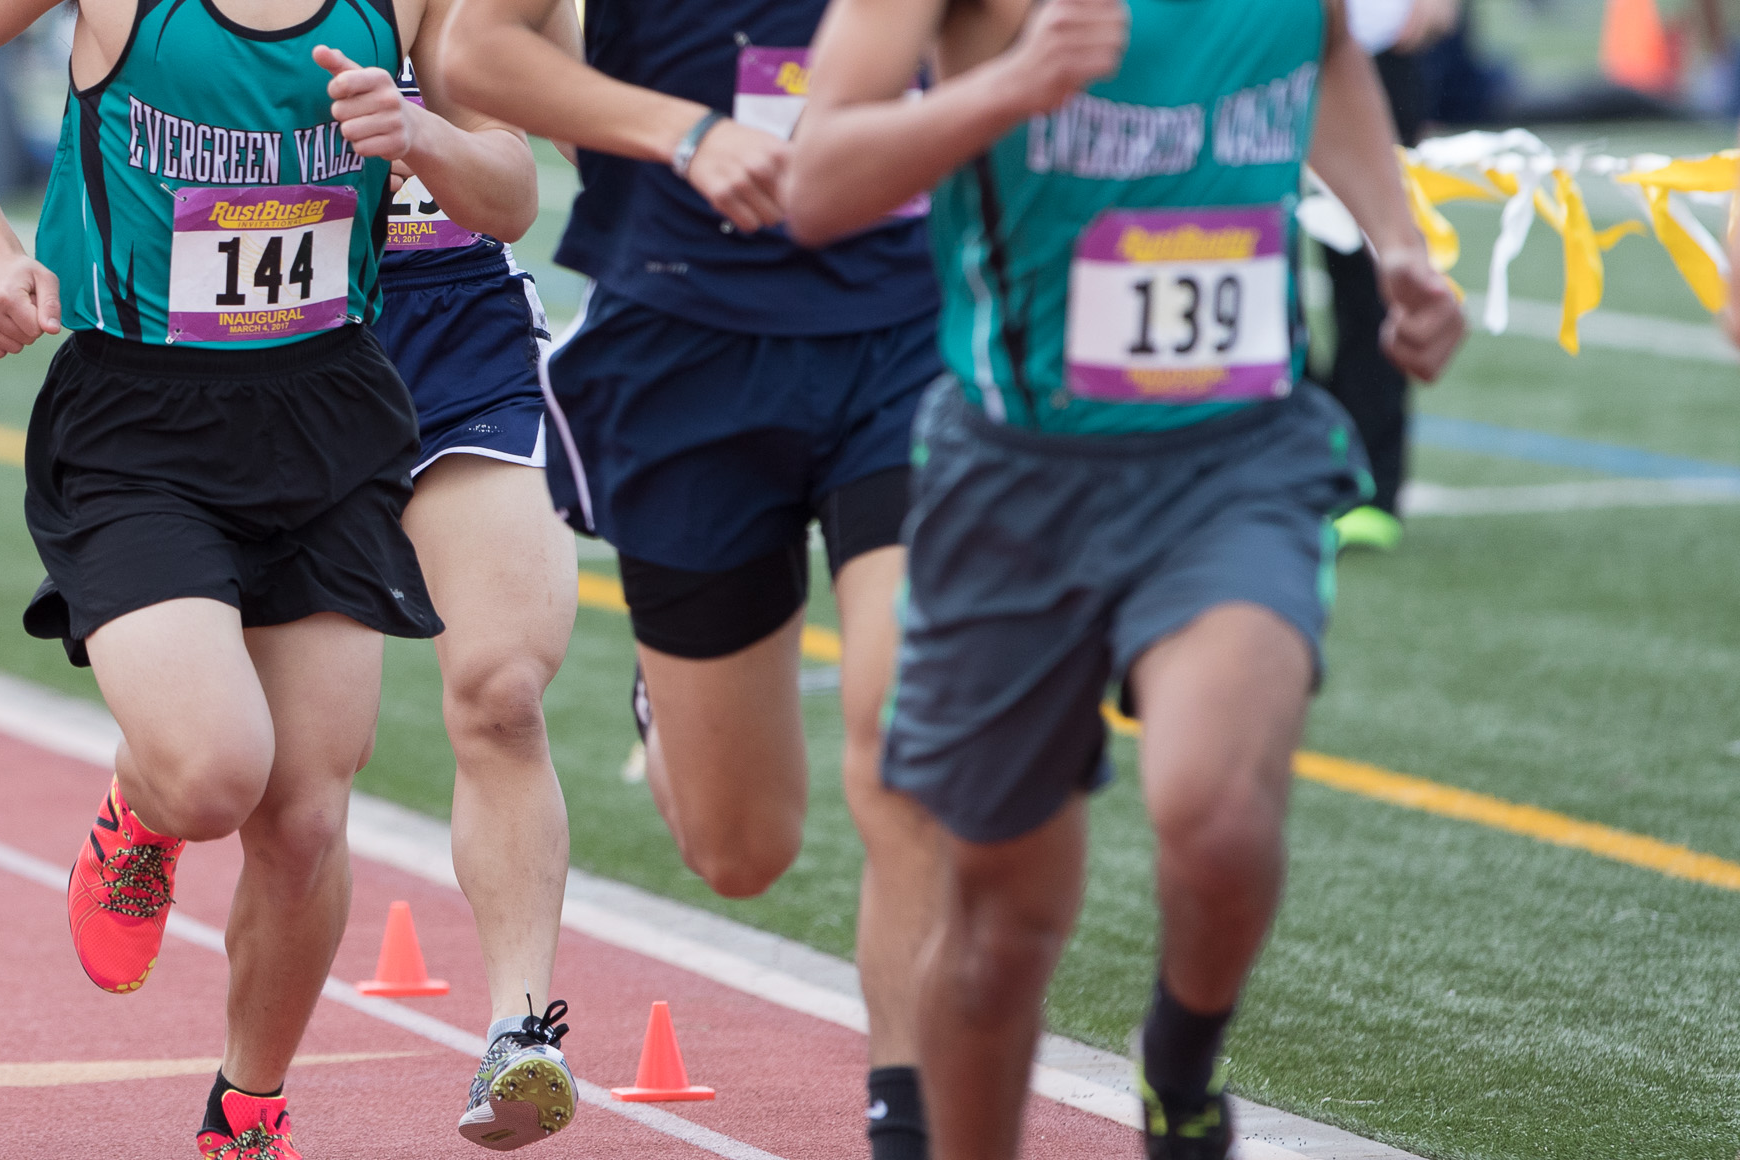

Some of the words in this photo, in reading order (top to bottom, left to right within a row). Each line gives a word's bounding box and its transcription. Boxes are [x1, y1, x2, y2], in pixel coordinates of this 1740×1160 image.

[128, 92, 283, 185] EVERGREEN
[208, 199, 330, 222] RustBuster
[402, 235, 421, 243] 2017
[216, 231, 315, 307] 144
[219, 308, 305, 326] INAUGURAL
[1126, 273, 1241, 354] 139
[229, 324, 261, 333] MARCH
[271, 322, 289, 331] 2017
